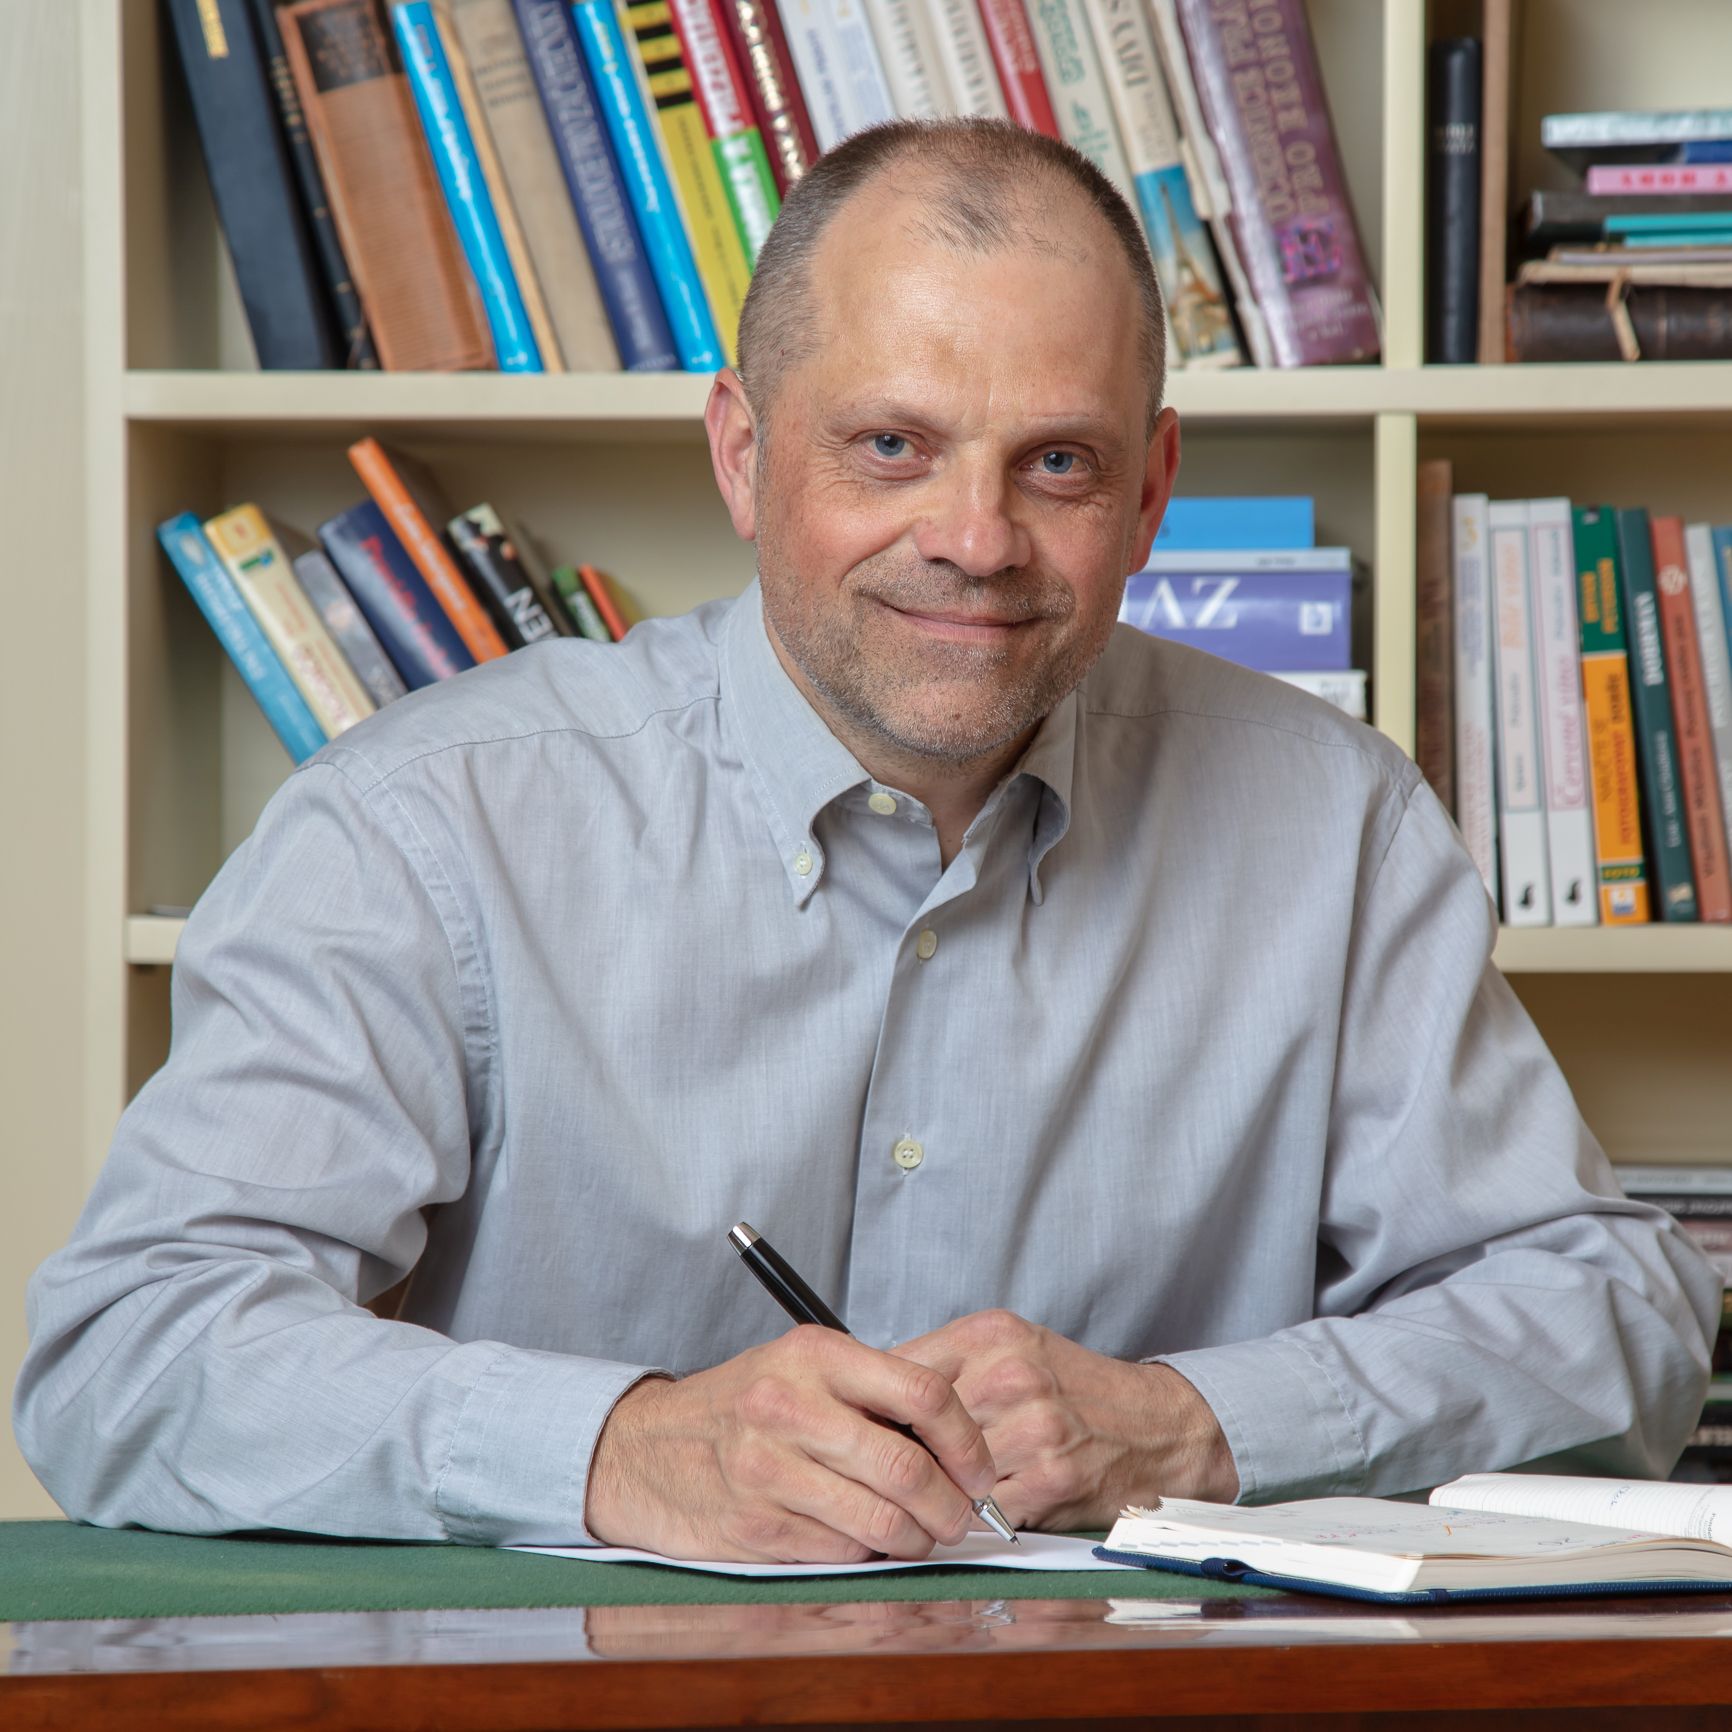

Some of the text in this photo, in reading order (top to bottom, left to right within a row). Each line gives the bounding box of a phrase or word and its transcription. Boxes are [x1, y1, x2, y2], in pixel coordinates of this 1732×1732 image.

[1246, 0, 1330, 217] PRO EKONO
[1118, 576, 1240, 630] AZ
